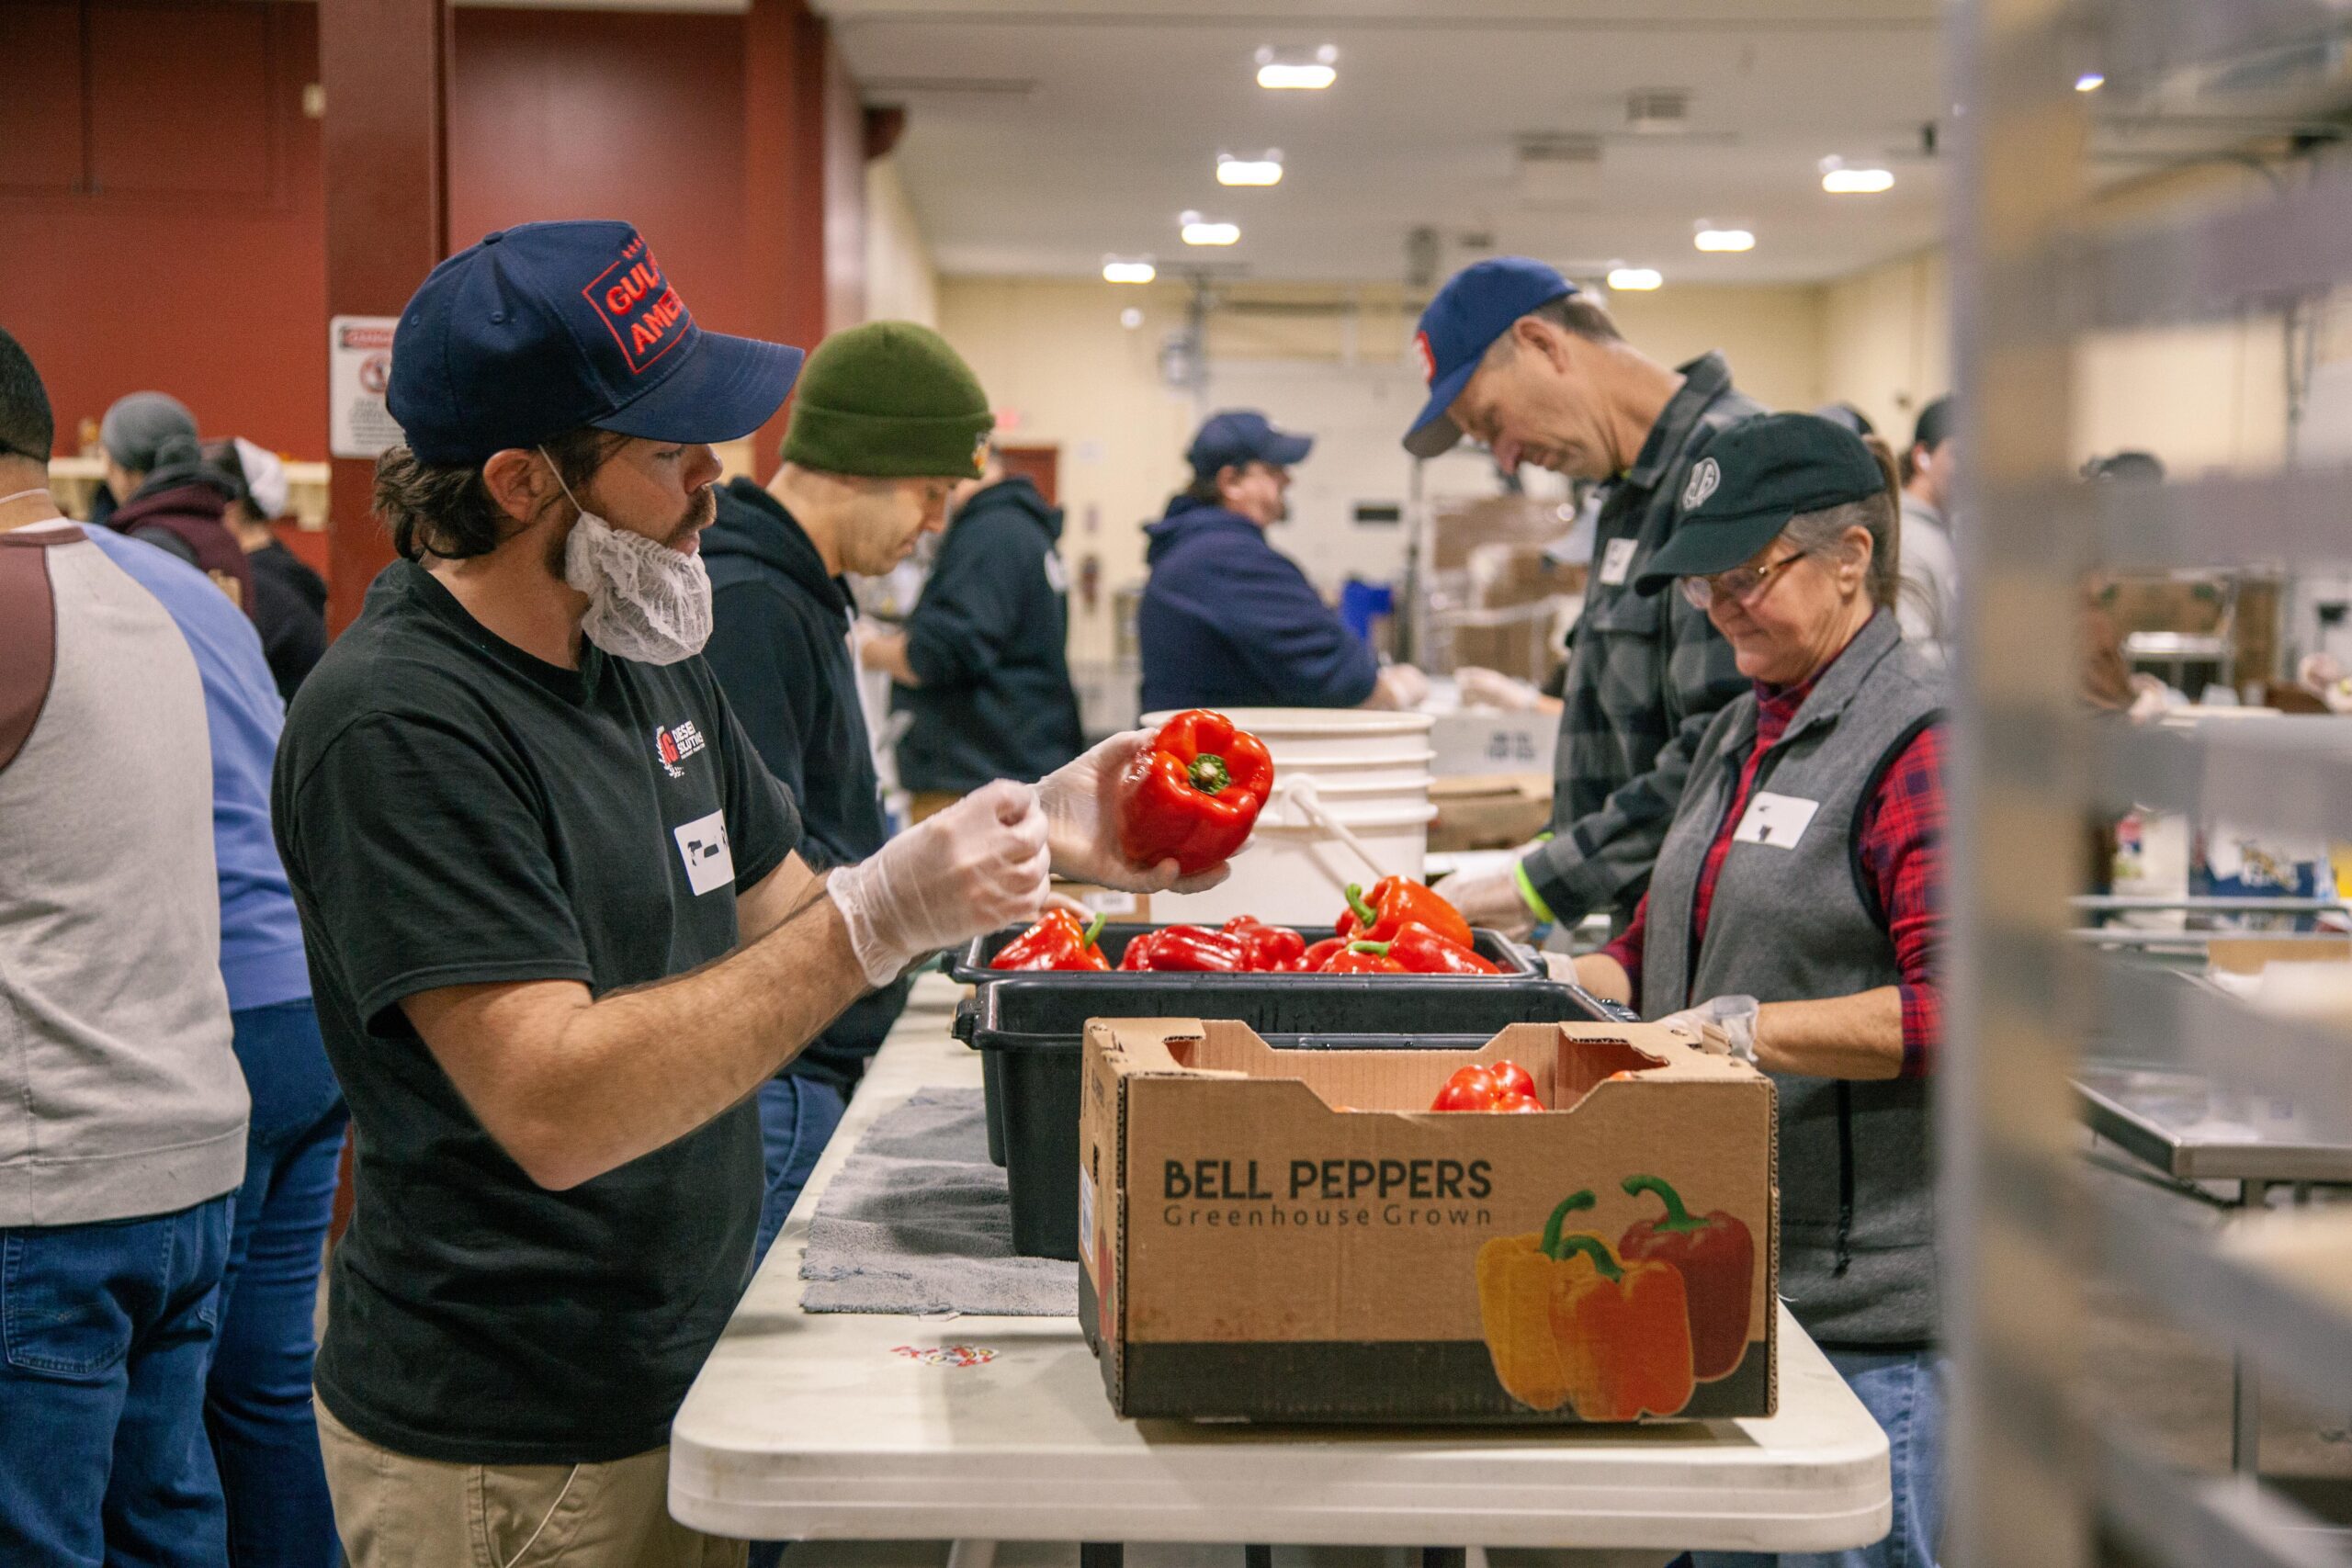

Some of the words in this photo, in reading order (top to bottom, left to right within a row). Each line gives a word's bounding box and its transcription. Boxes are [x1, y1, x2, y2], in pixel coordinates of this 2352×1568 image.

[605, 249, 660, 316] GUL
[630, 283, 684, 355] AME
[1164, 1159, 1273, 1200] BELL
[1289, 1159, 1493, 1200] PEPPERS
[1163, 1203, 1370, 1226] Greenhouse
[1383, 1203, 1492, 1226] Grown
